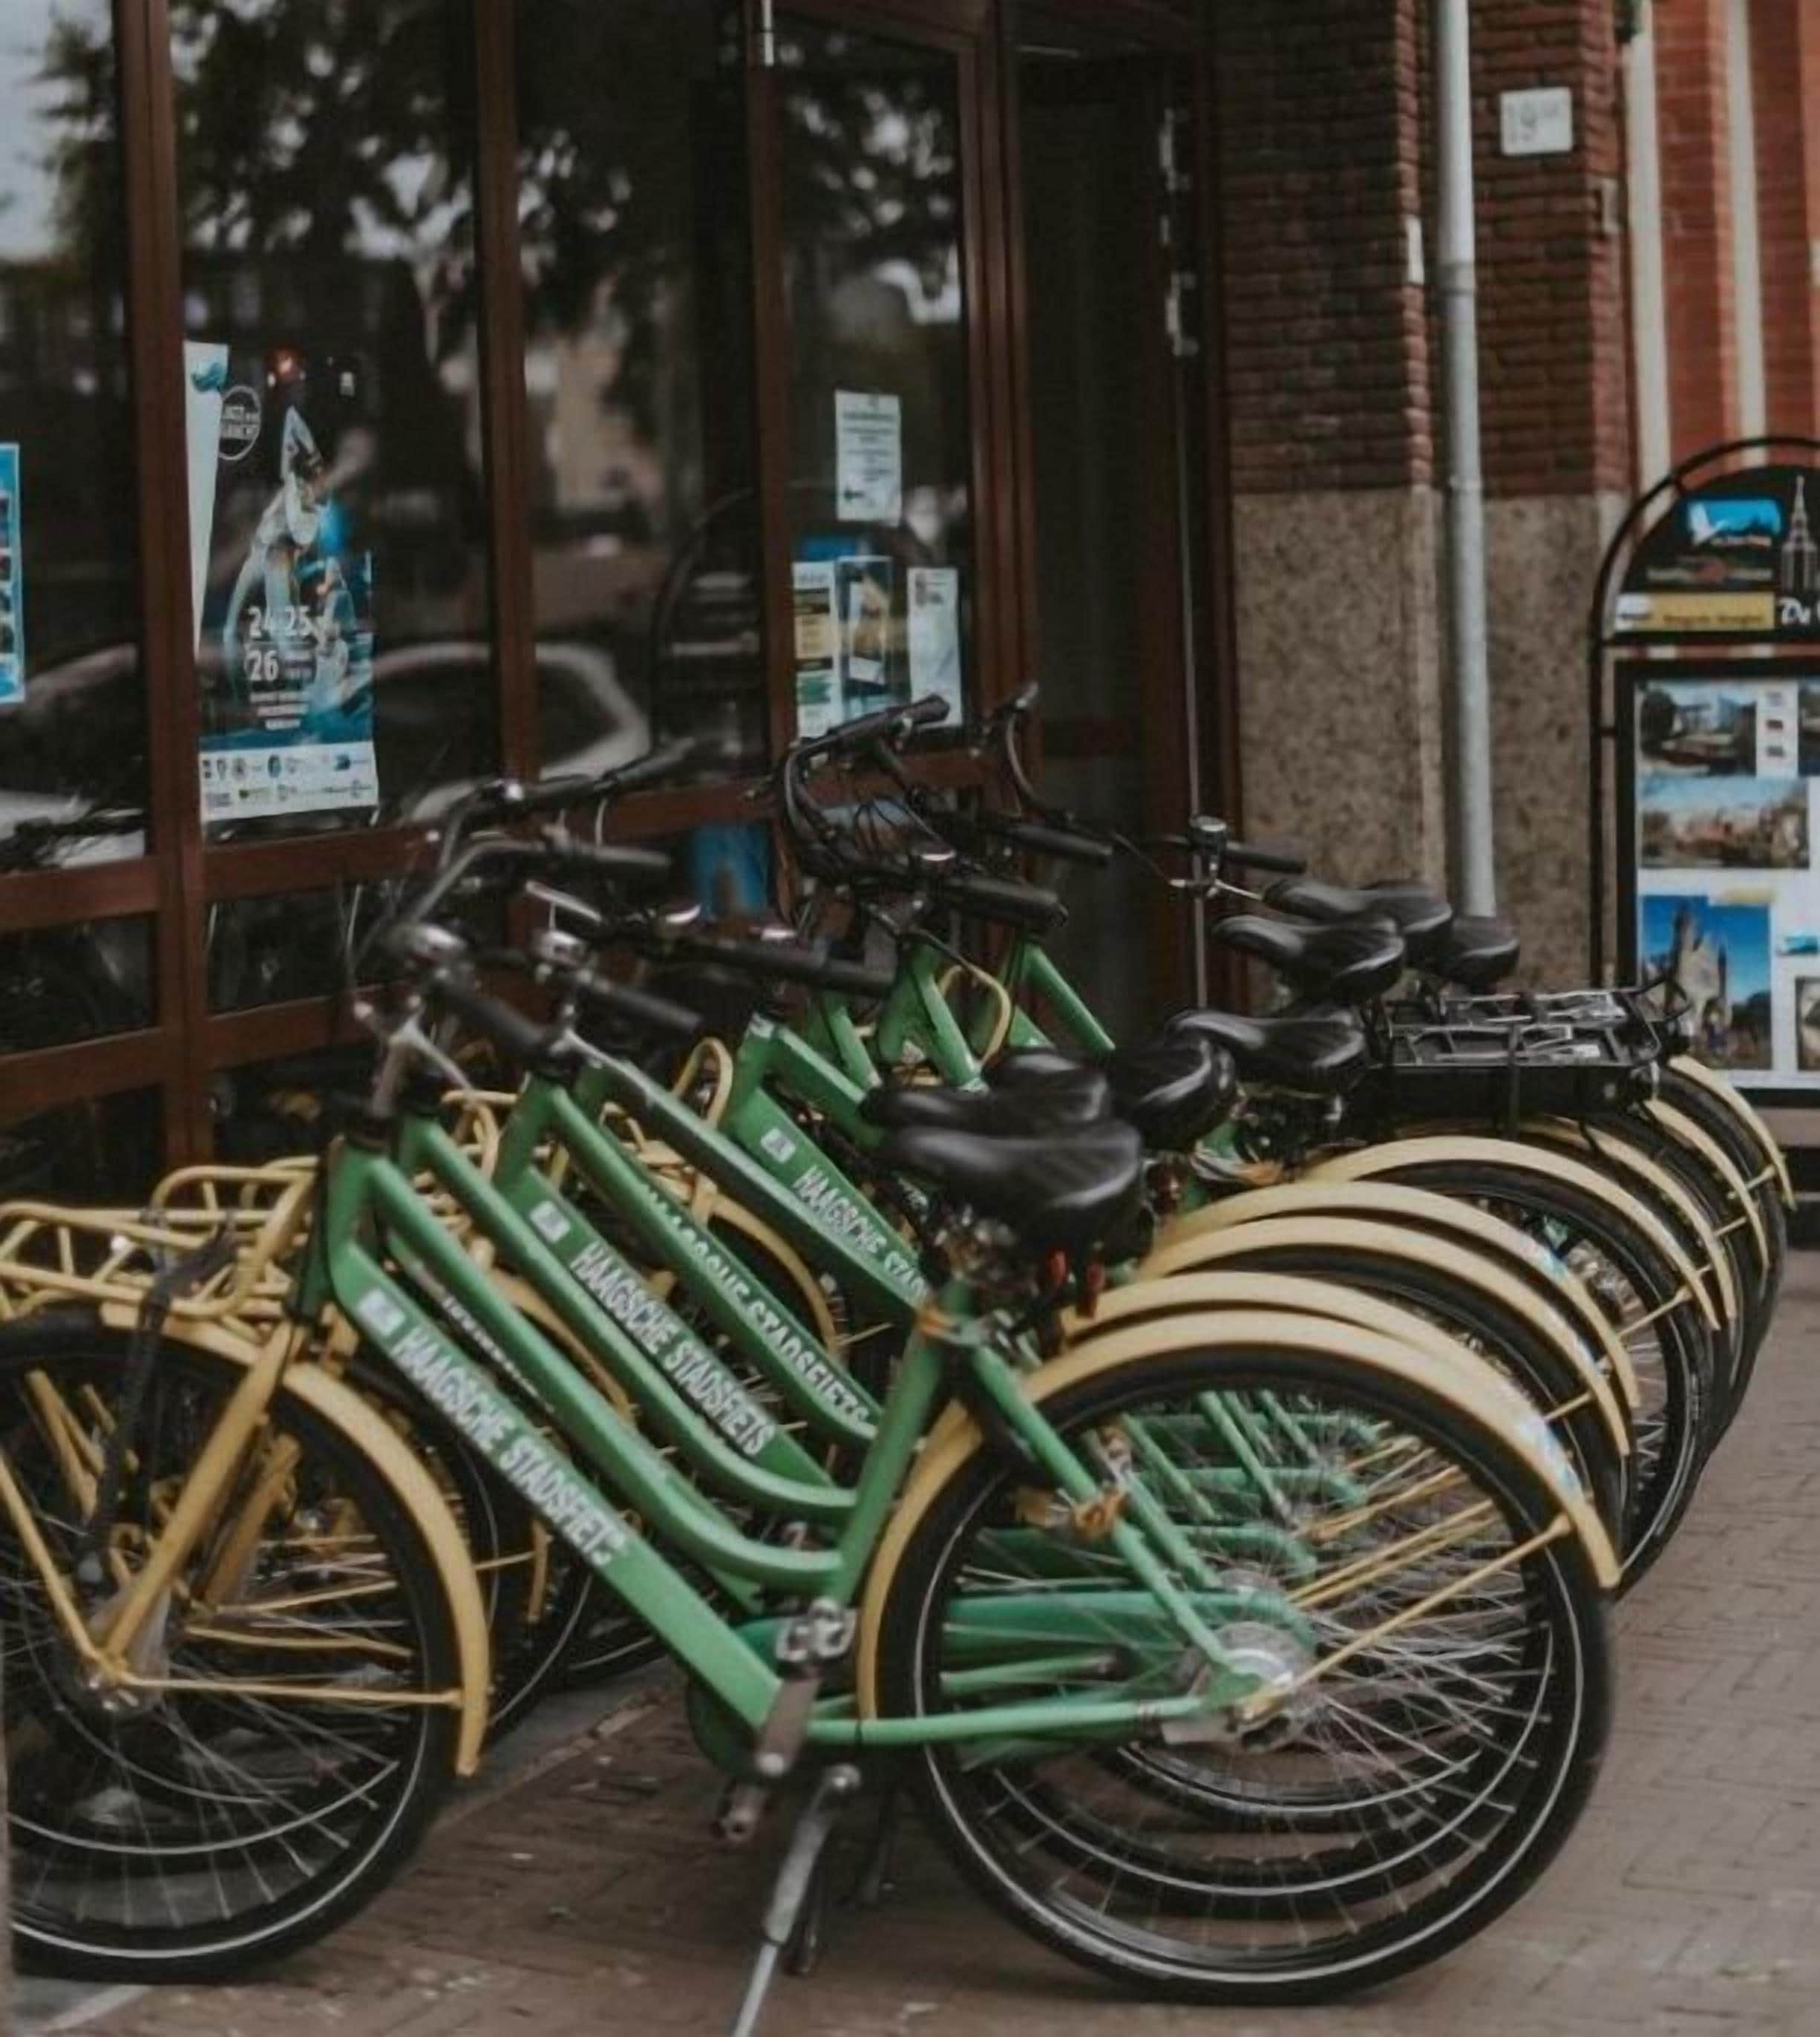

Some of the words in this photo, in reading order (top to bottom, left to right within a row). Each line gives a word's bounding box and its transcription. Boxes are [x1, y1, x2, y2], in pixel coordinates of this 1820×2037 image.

[391, 1327, 515, 1451] HAAGSCHE
[499, 1433, 626, 1566] STADSFIETS
[571, 1241, 678, 1354] HAAGSCHE
[664, 1341, 776, 1456] STADSFIETS
